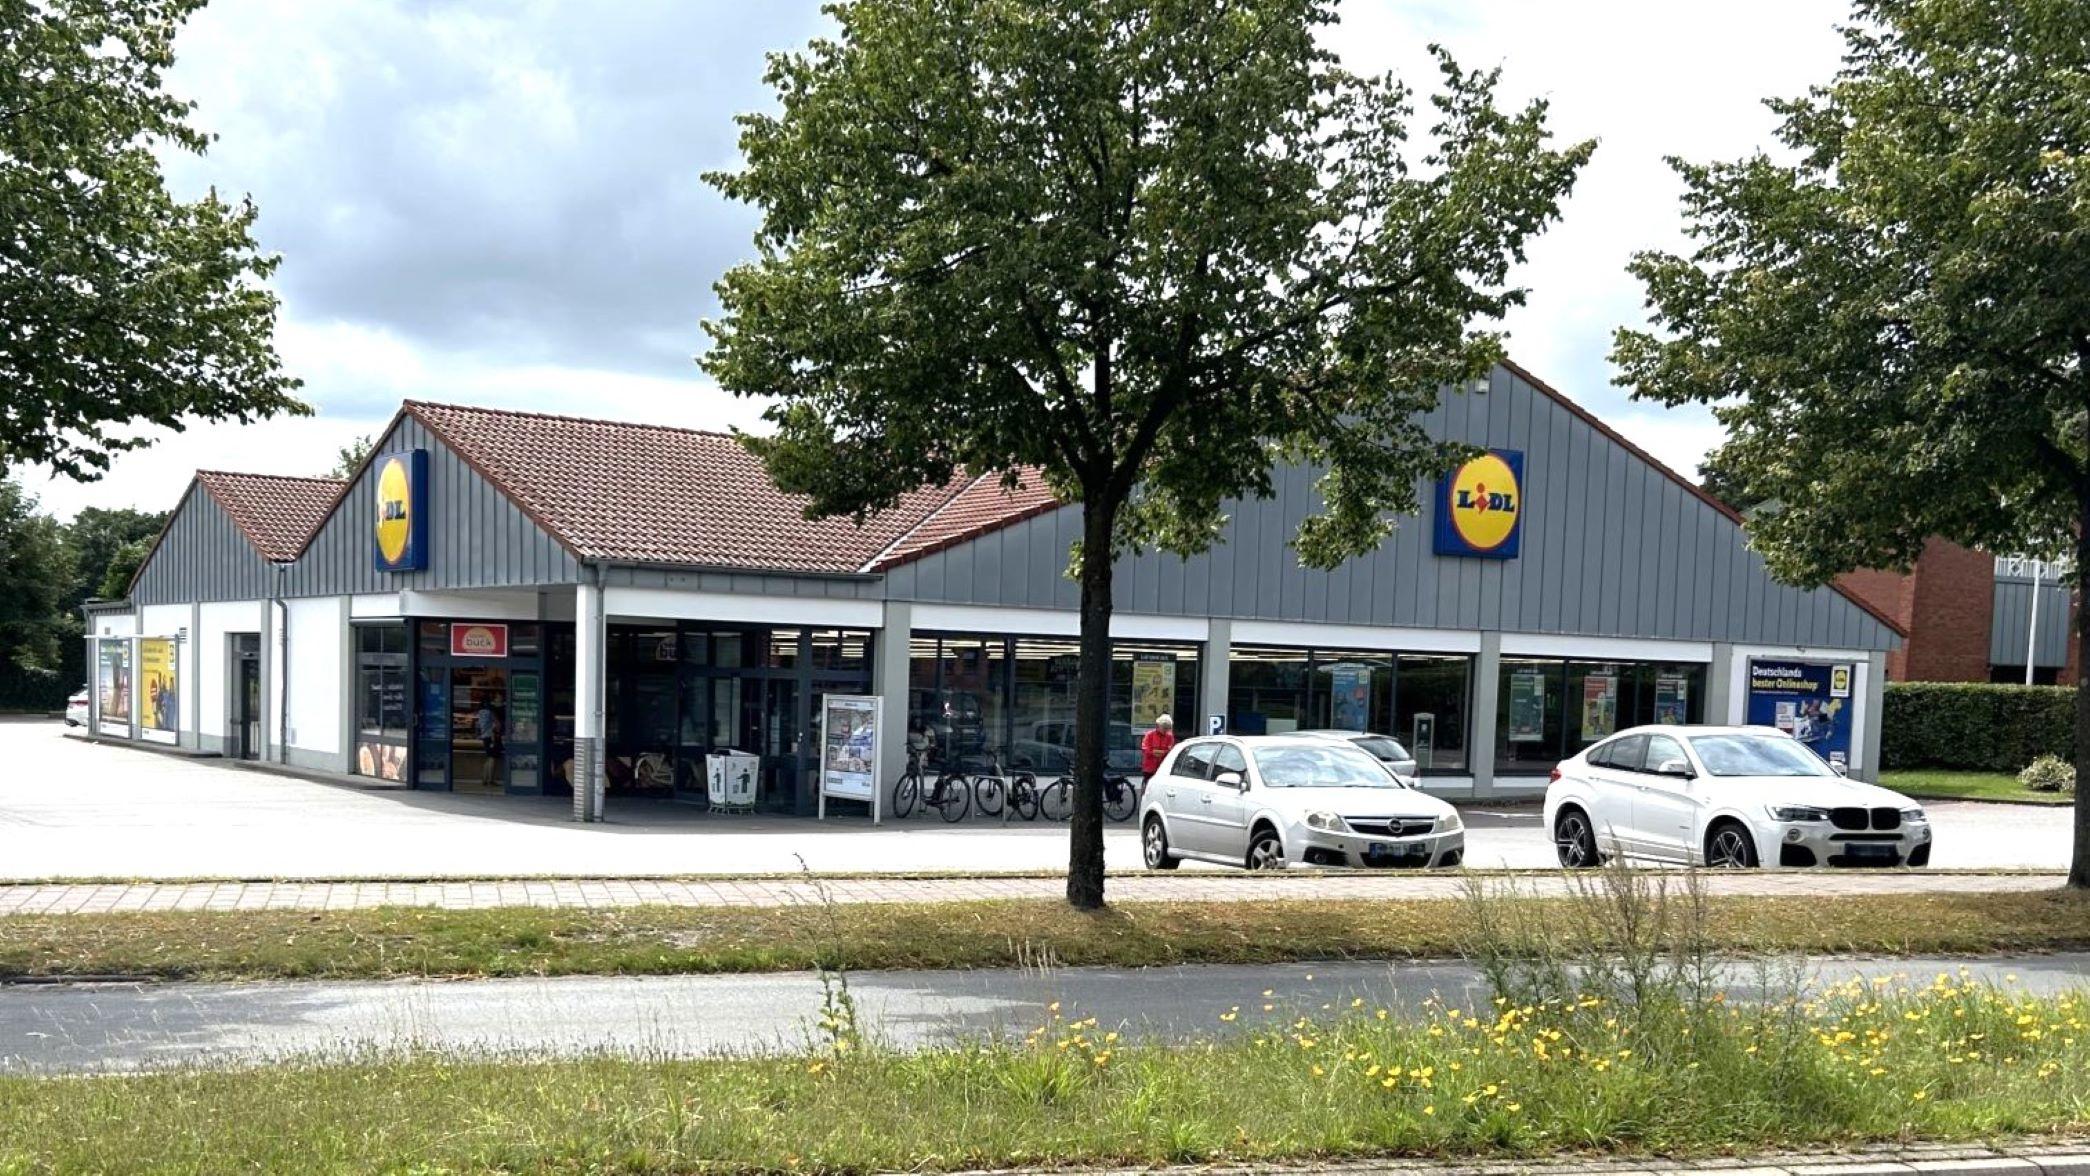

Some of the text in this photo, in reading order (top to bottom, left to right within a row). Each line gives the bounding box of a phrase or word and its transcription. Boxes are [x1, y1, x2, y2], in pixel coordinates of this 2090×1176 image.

[1752, 665, 1802, 678] Deutschlands
[1752, 677, 1819, 692] bester Onlineshop
[1209, 716, 1222, 735] P
